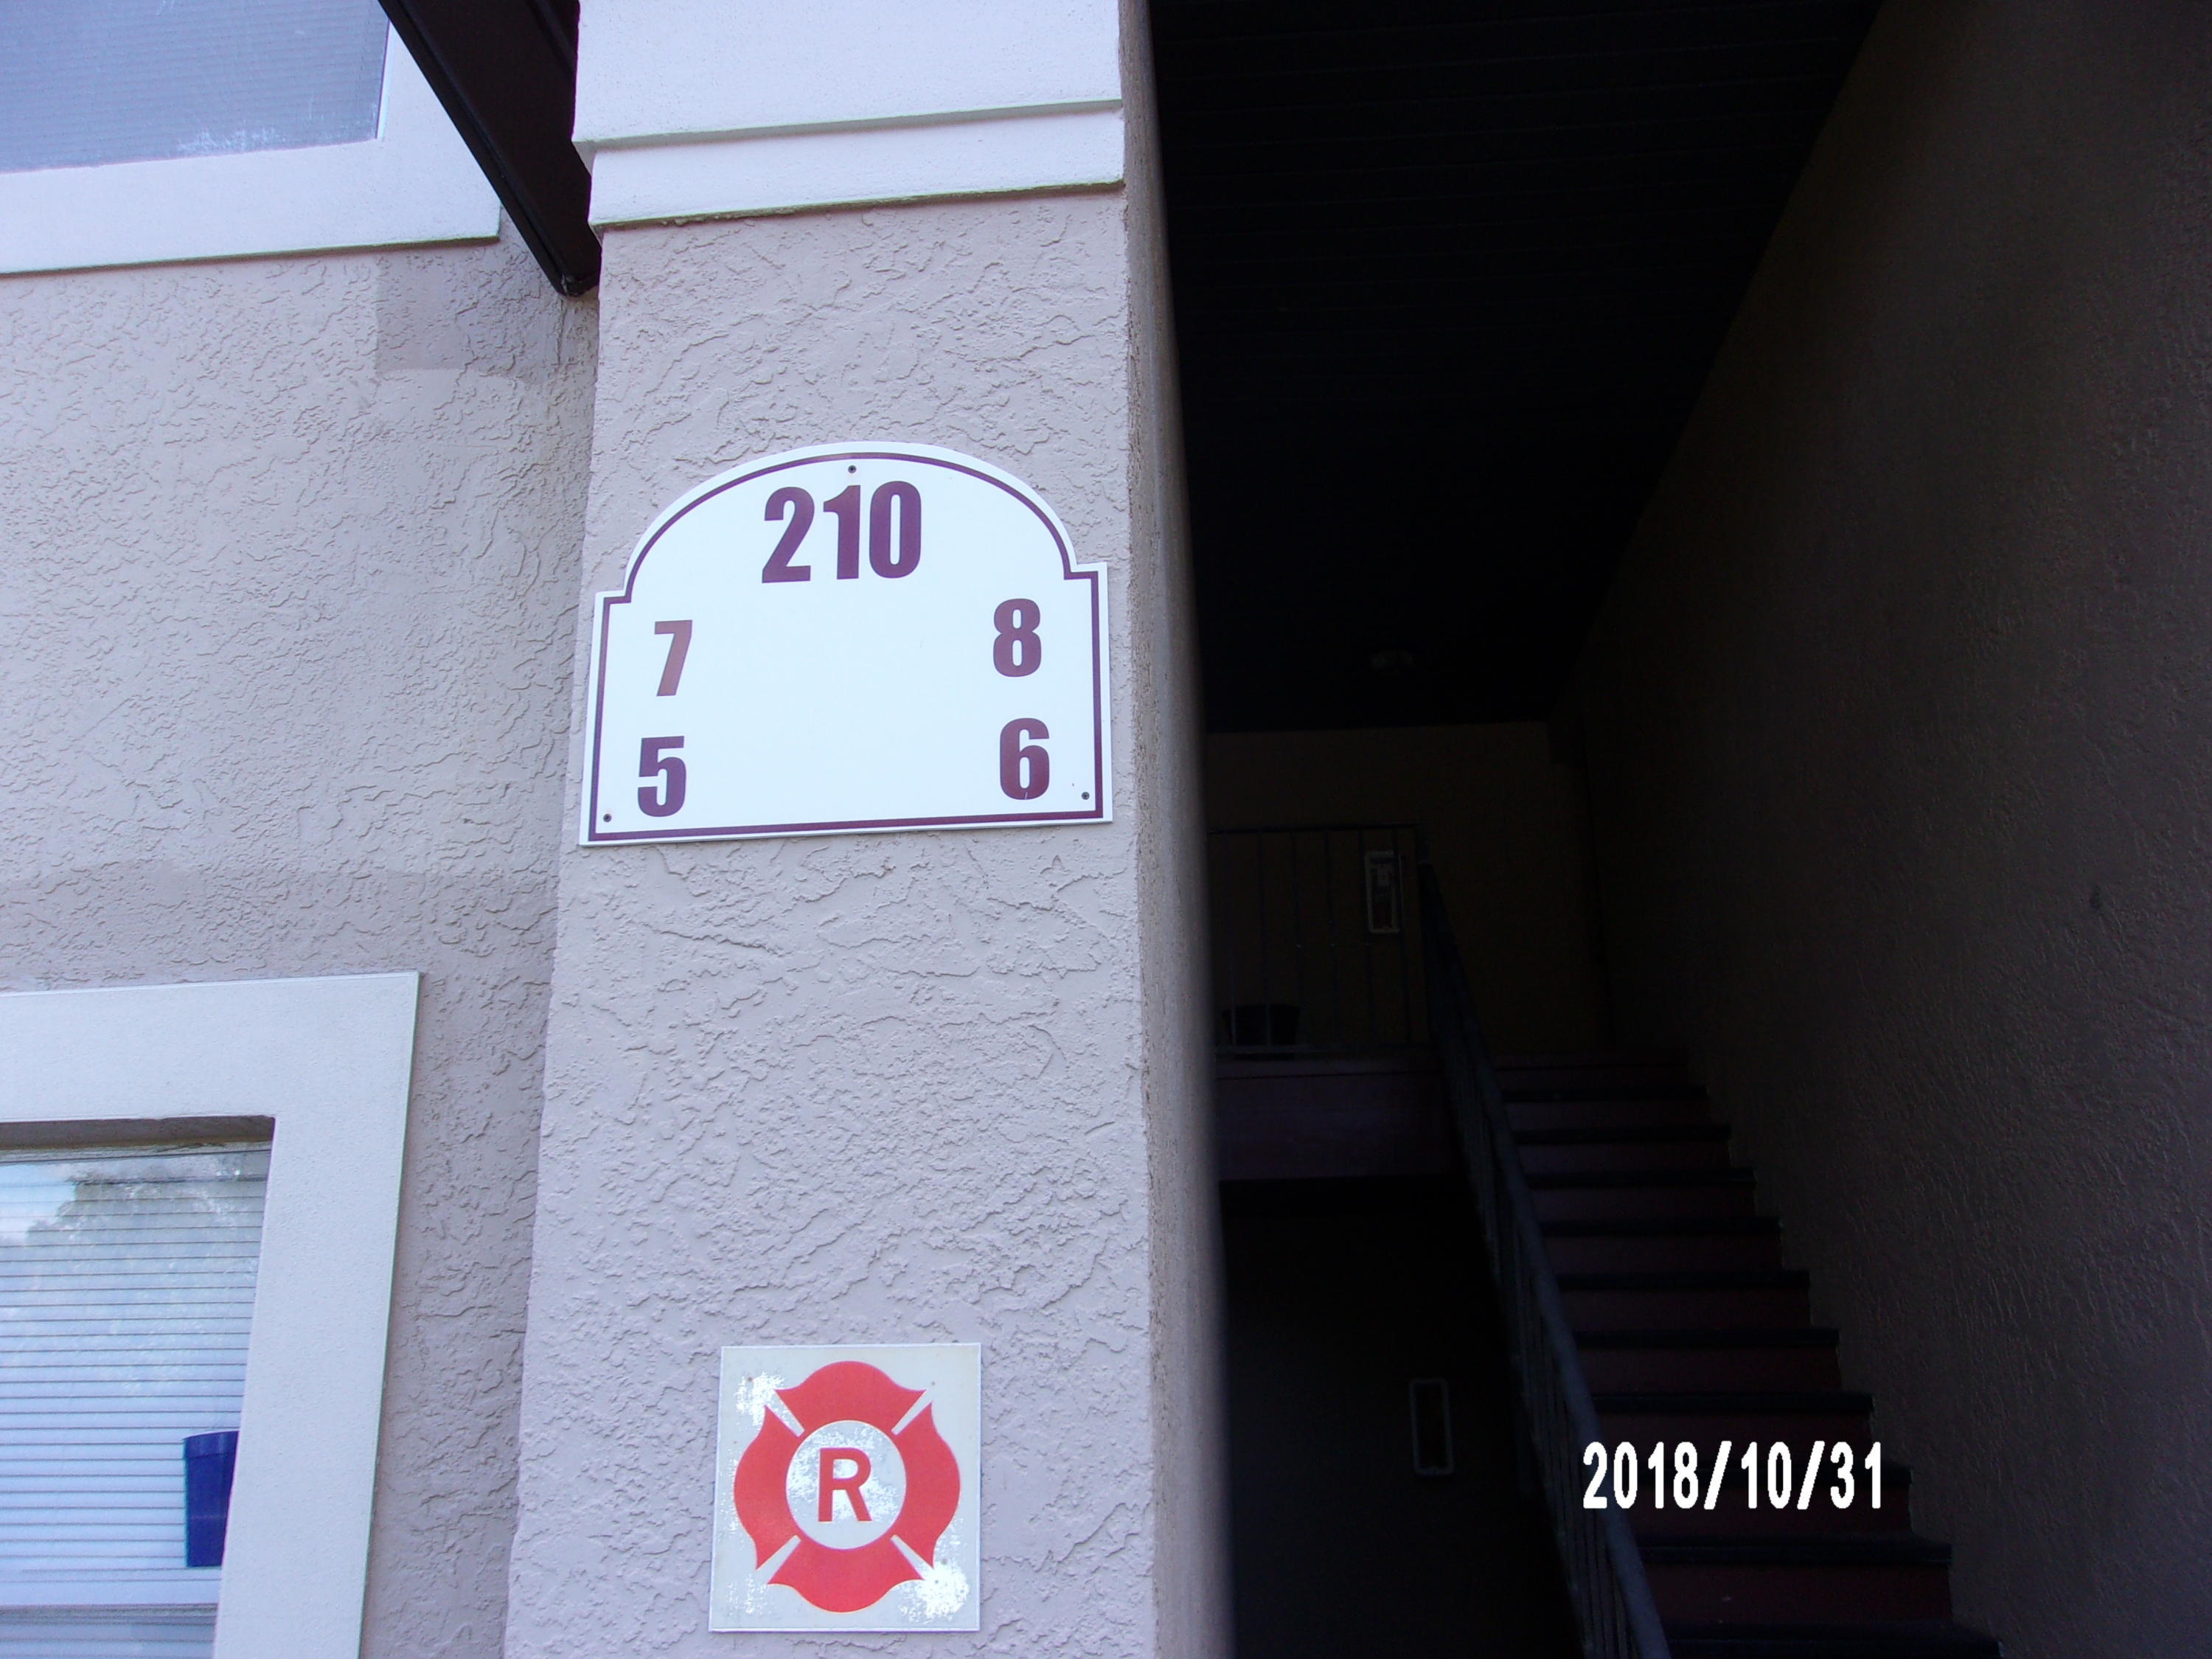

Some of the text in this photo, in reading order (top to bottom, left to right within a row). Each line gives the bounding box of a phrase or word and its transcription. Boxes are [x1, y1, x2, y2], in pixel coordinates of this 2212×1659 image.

[762, 480, 922, 584] 210
[654, 619, 693, 697] 7
[992, 598, 1042, 678] 8
[637, 735, 687, 817] 5
[999, 717, 1050, 800] 6
[818, 1447, 873, 1523] R
